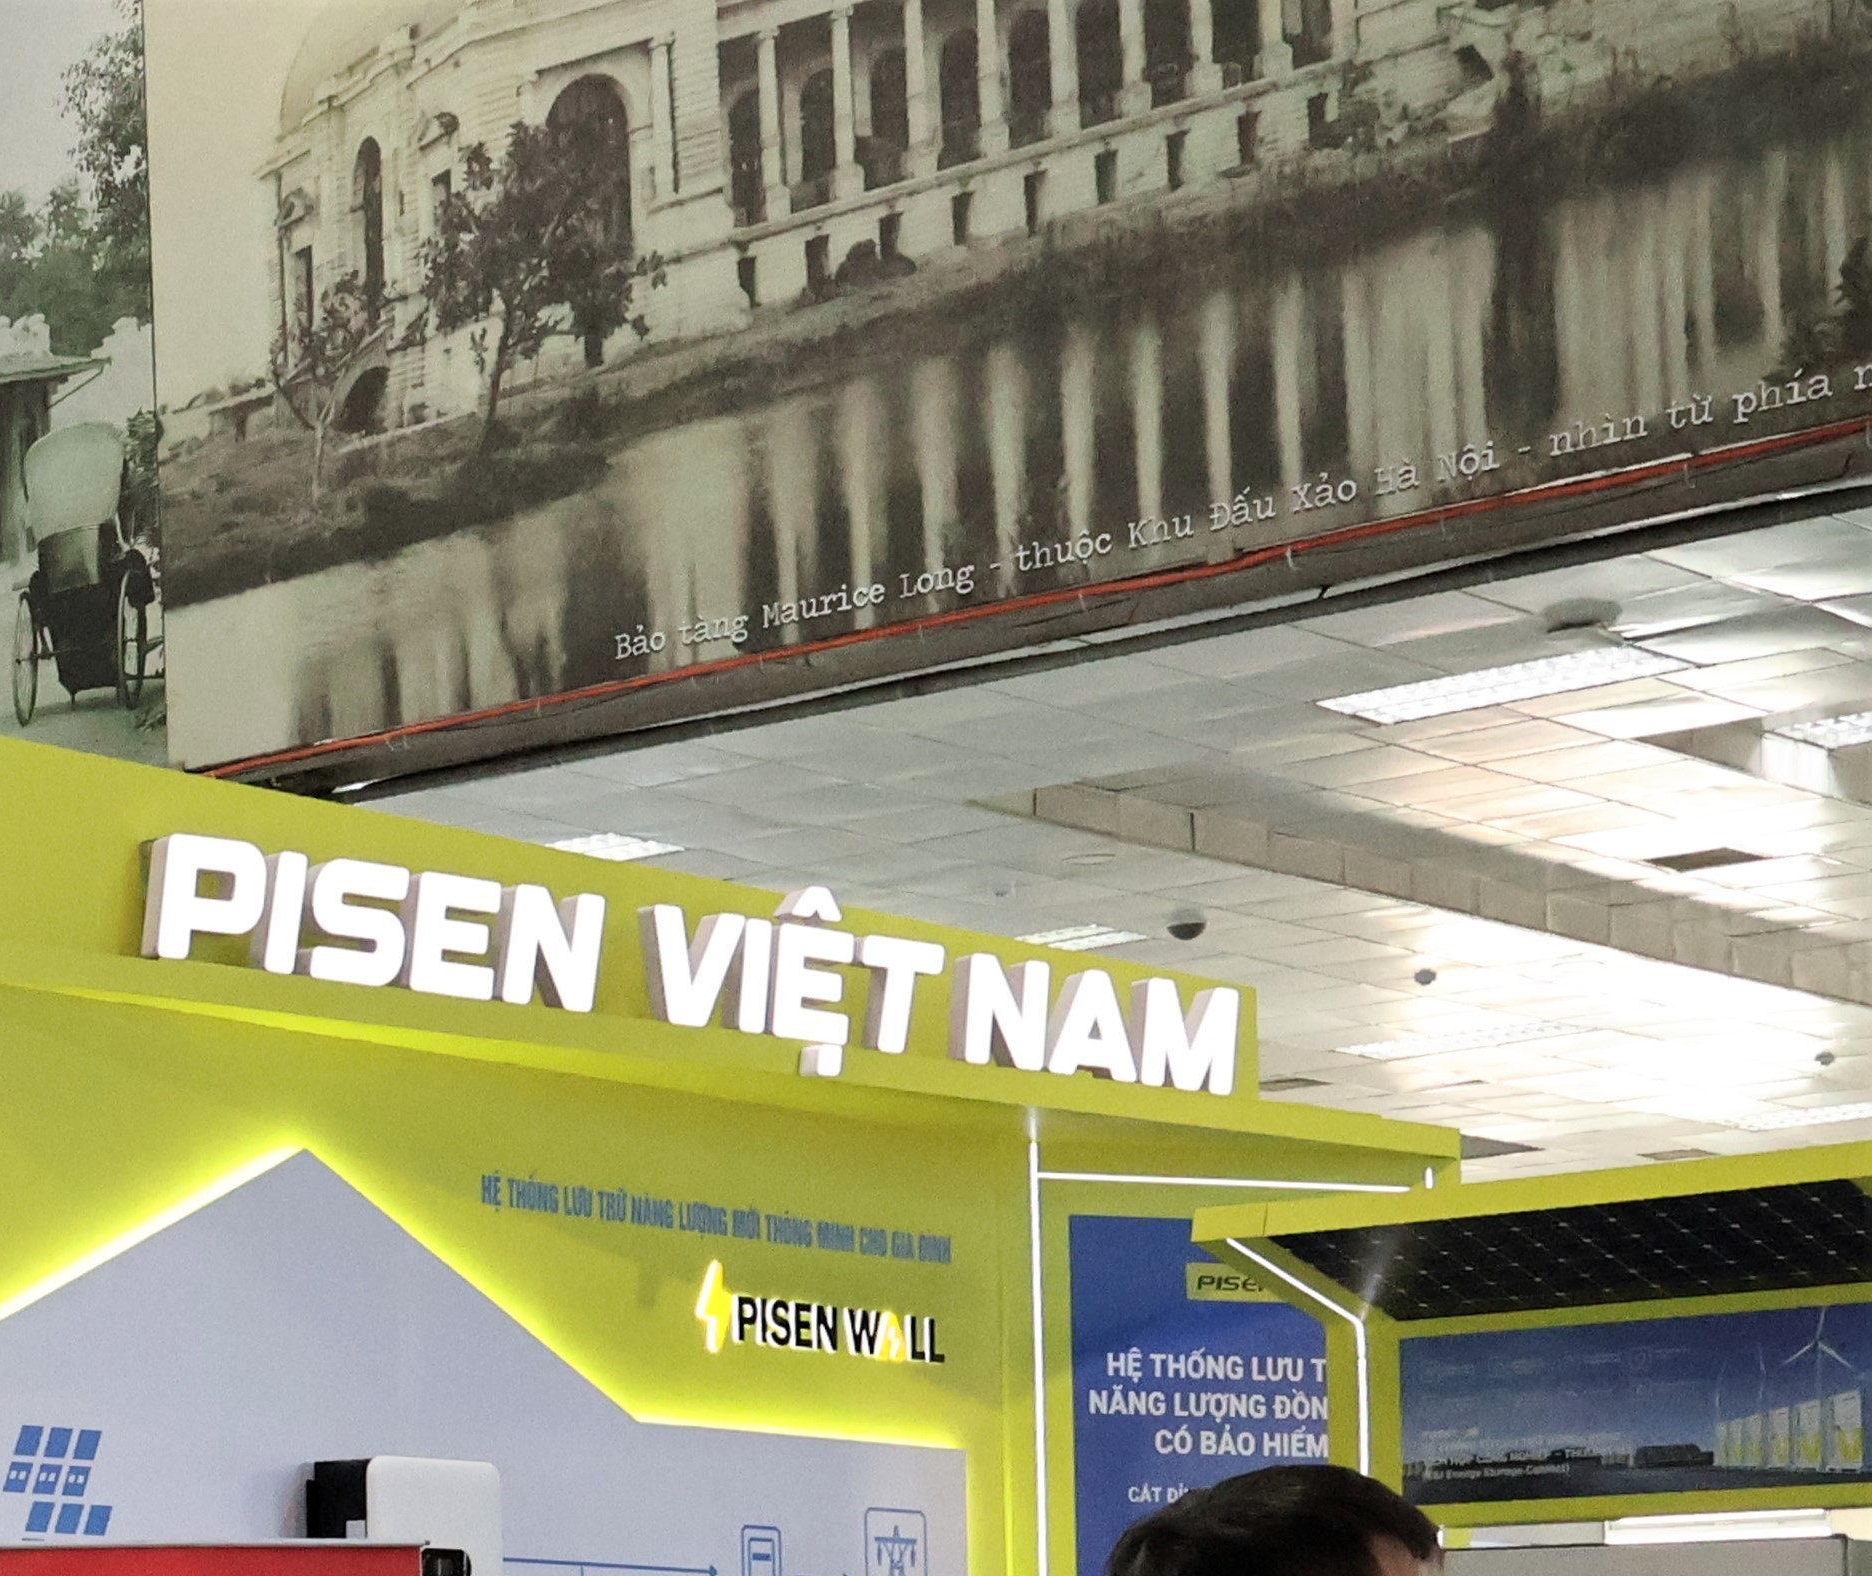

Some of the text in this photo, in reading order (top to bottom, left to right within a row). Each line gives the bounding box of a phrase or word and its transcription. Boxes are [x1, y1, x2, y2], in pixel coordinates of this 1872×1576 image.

[615, 625, 665, 660] Bảo
[677, 615, 749, 649] tàng
[761, 582, 885, 629] Maurice
[899, 564, 975, 598] Long
[1015, 532, 1111, 572] thuộc
[1127, 510, 1195, 549] Khu
[1208, 493, 1275, 531] Đấu
[1291, 471, 1356, 513] Xảo
[1438, 442, 1501, 485] Nội
[1549, 410, 1647, 455] nhìn
[1666, 389, 1713, 429] từ
[1733, 366, 1831, 425] phía
[148, 832, 1240, 1095] PISEN VIỆT NAM
[732, 1293, 838, 1353] PISEN
[1105, 1346, 1143, 1384] HỆ
[1151, 1342, 1243, 1382] THỐNG
[1088, 1384, 1166, 1416] NĂNG
[1155, 1422, 1193, 1456] CÓ
